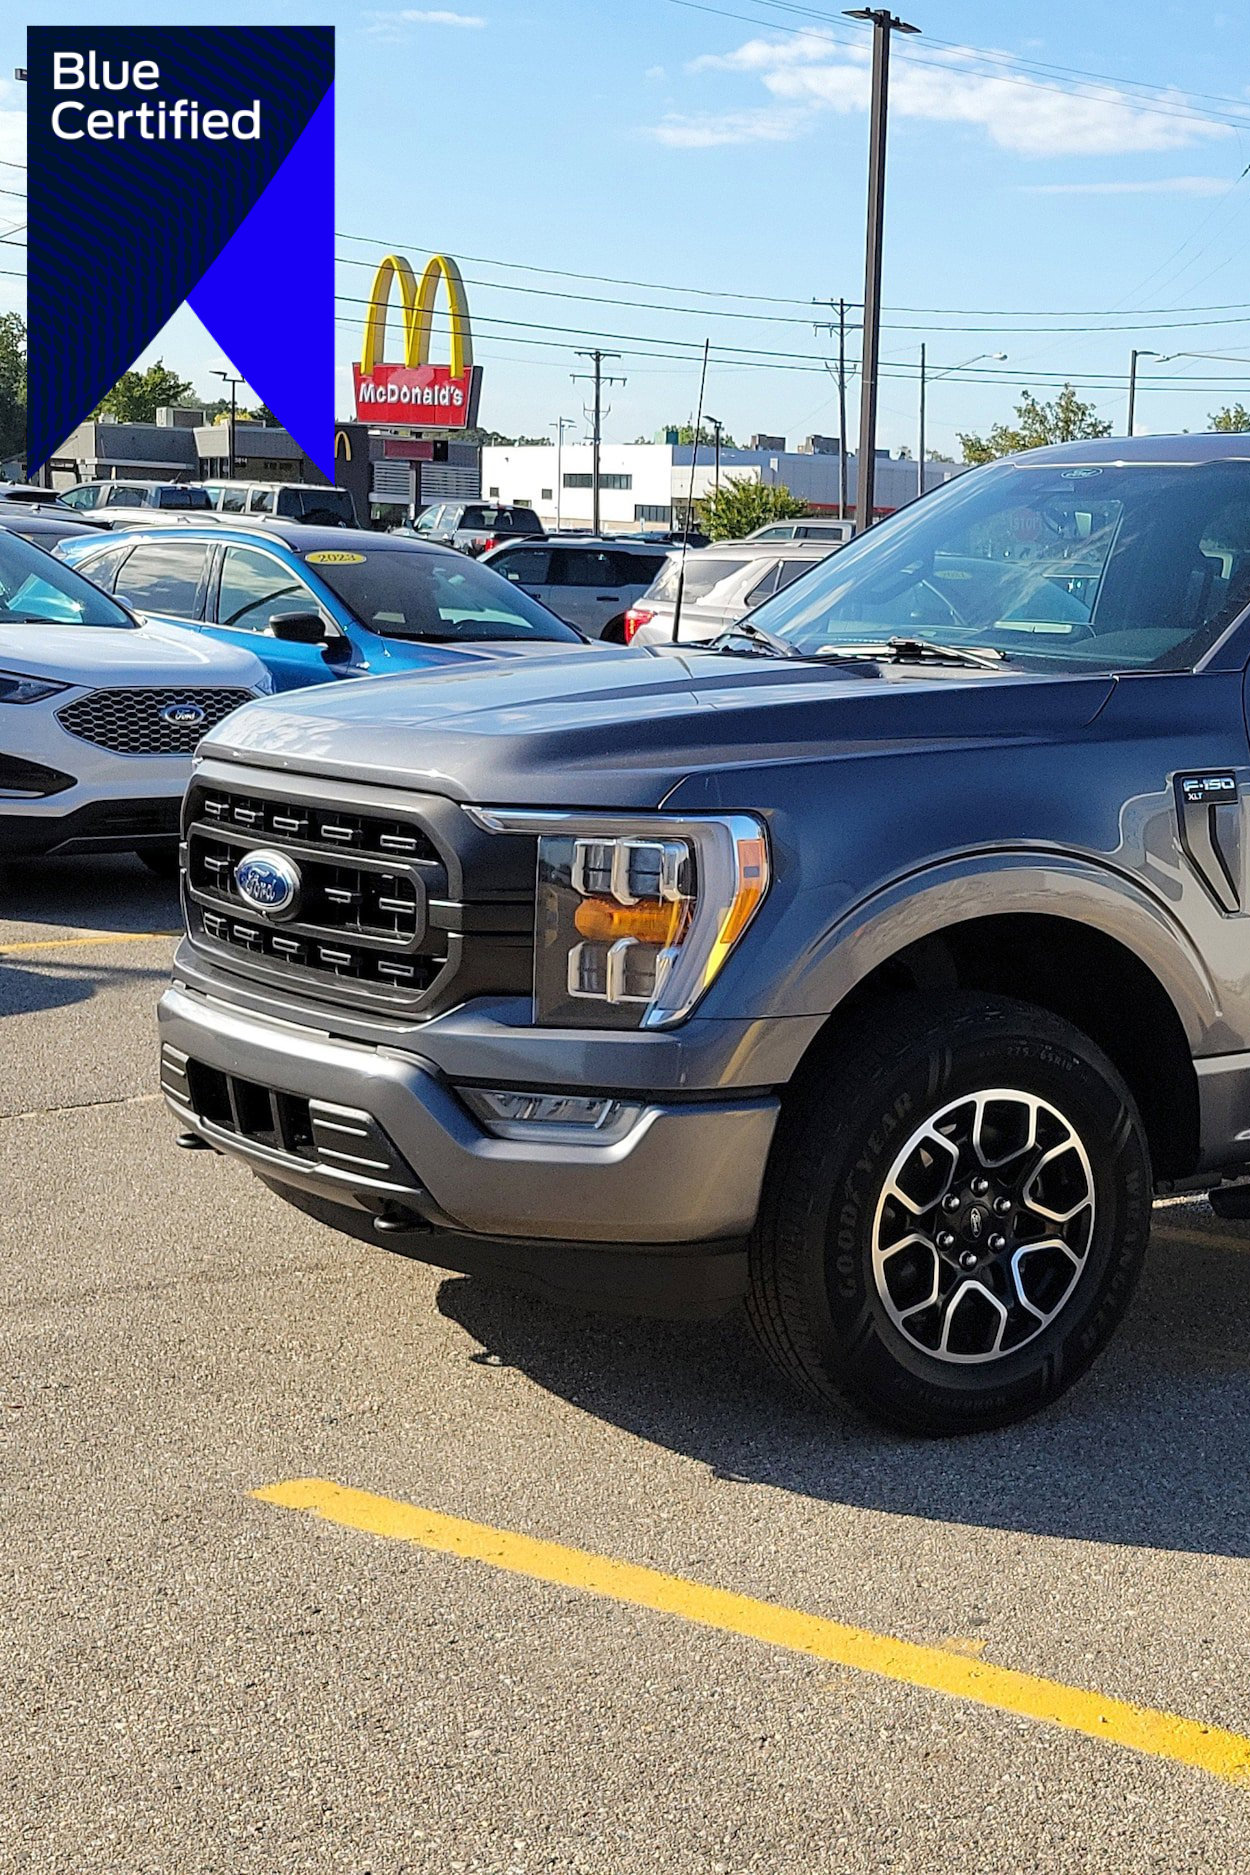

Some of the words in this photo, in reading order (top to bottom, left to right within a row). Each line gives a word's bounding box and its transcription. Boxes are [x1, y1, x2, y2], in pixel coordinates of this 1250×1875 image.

[359, 382, 465, 406] McDonald's
[1183, 777, 1235, 792] F-150
[1187, 792, 1204, 801] XLT
[245, 866, 278, 901] Ford
